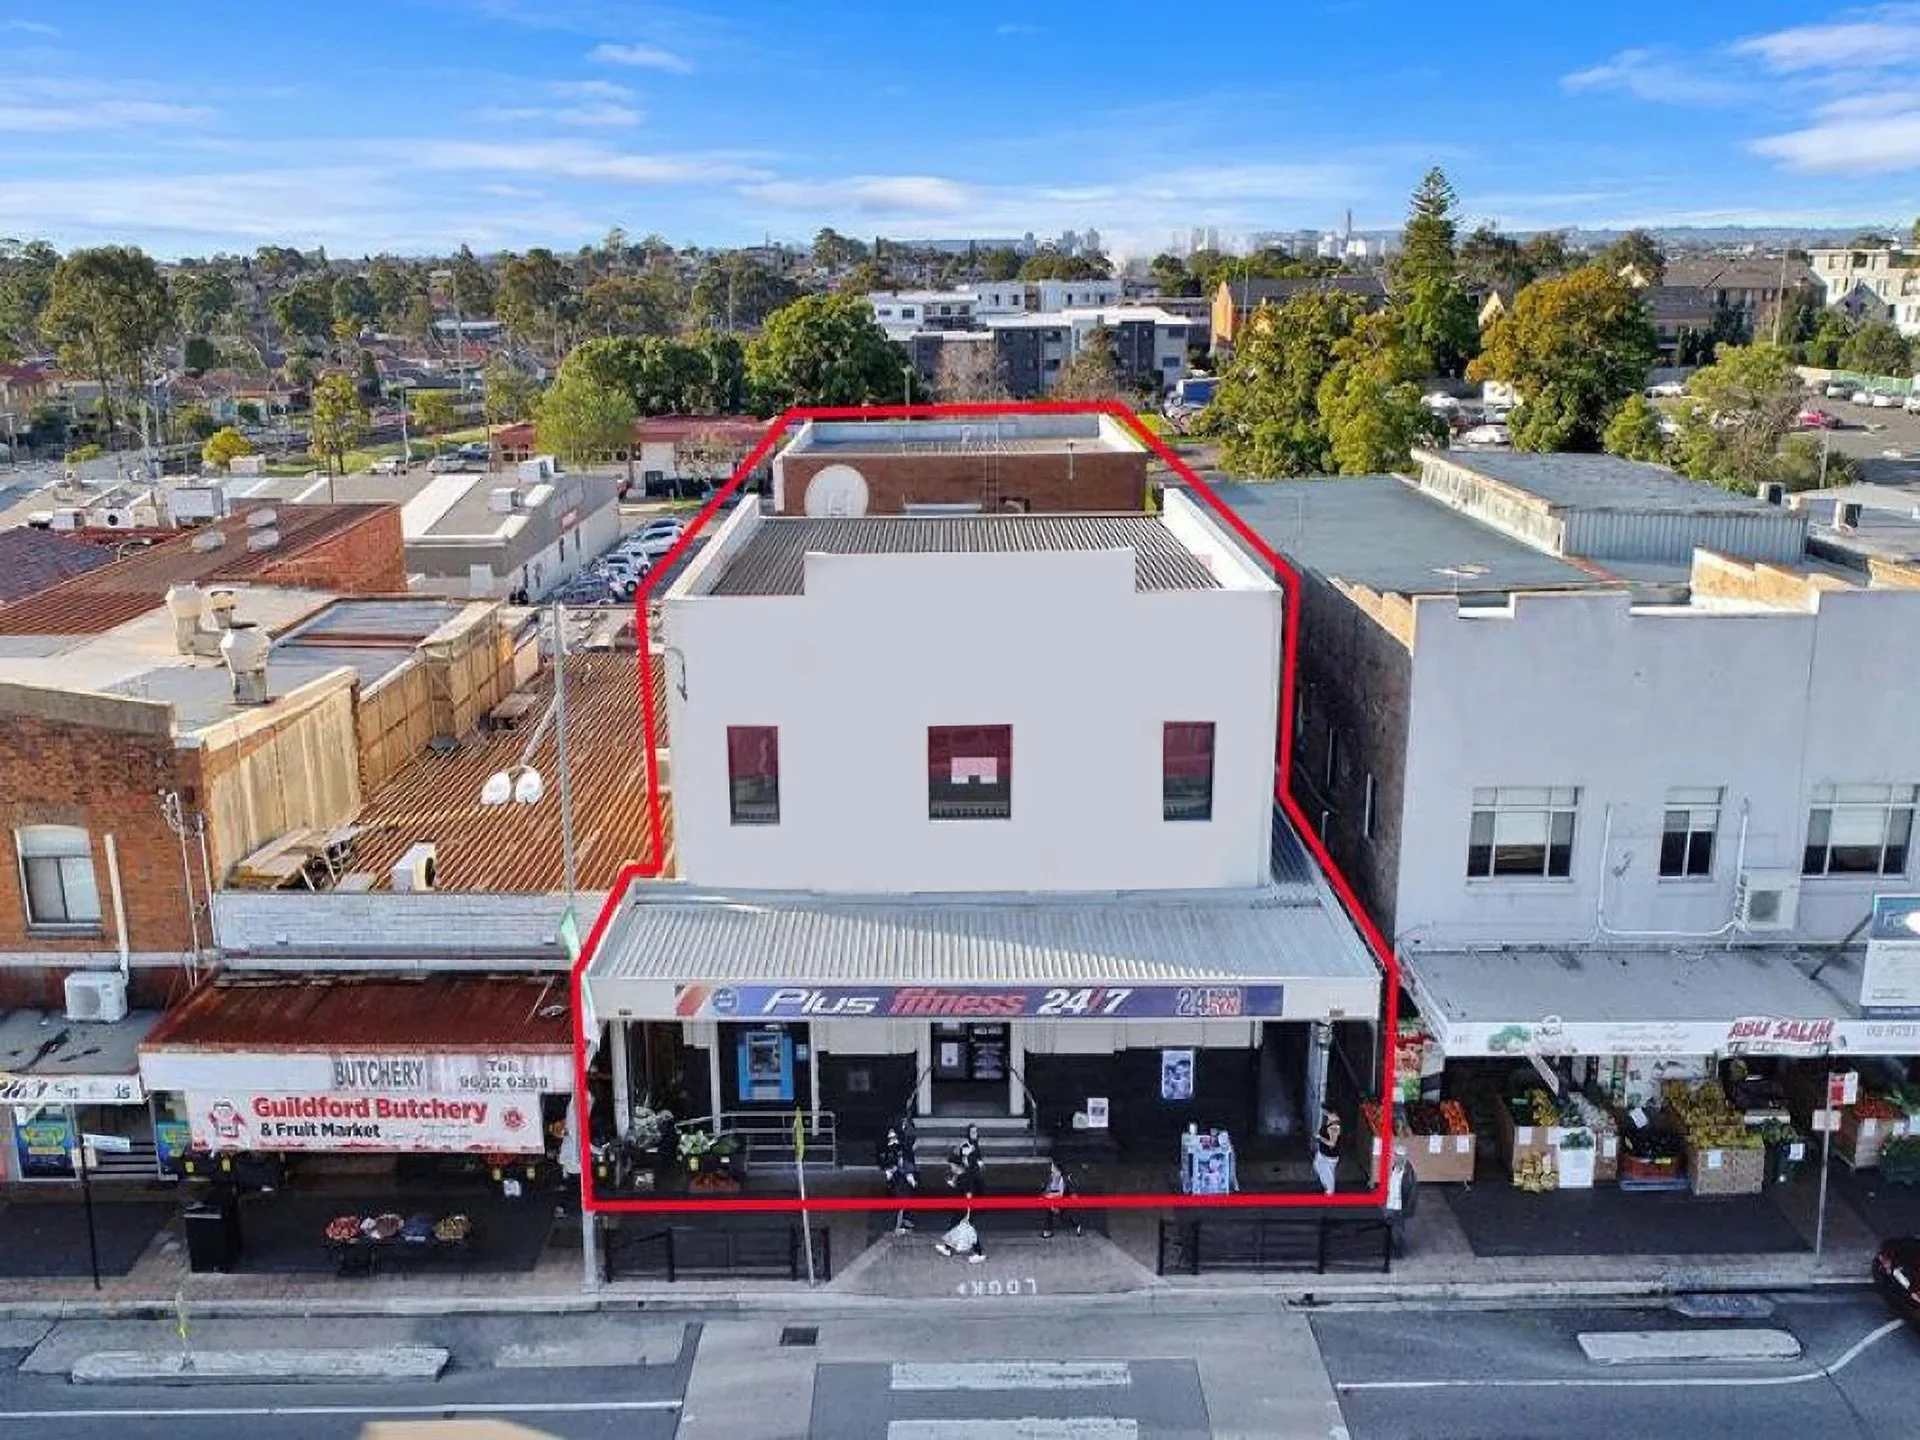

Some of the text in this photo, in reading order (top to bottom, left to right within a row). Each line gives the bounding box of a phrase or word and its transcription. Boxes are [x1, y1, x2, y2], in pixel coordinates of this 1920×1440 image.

[763, 987, 1133, 1017] Plus fitness 24/7
[1727, 1020, 1772, 1039] ABU
[333, 1060, 425, 1087] BUTCHERY
[253, 1096, 488, 1124] Guildford Butchery
[276, 1122, 317, 1138] Fruit
[321, 1122, 381, 1138] Market
